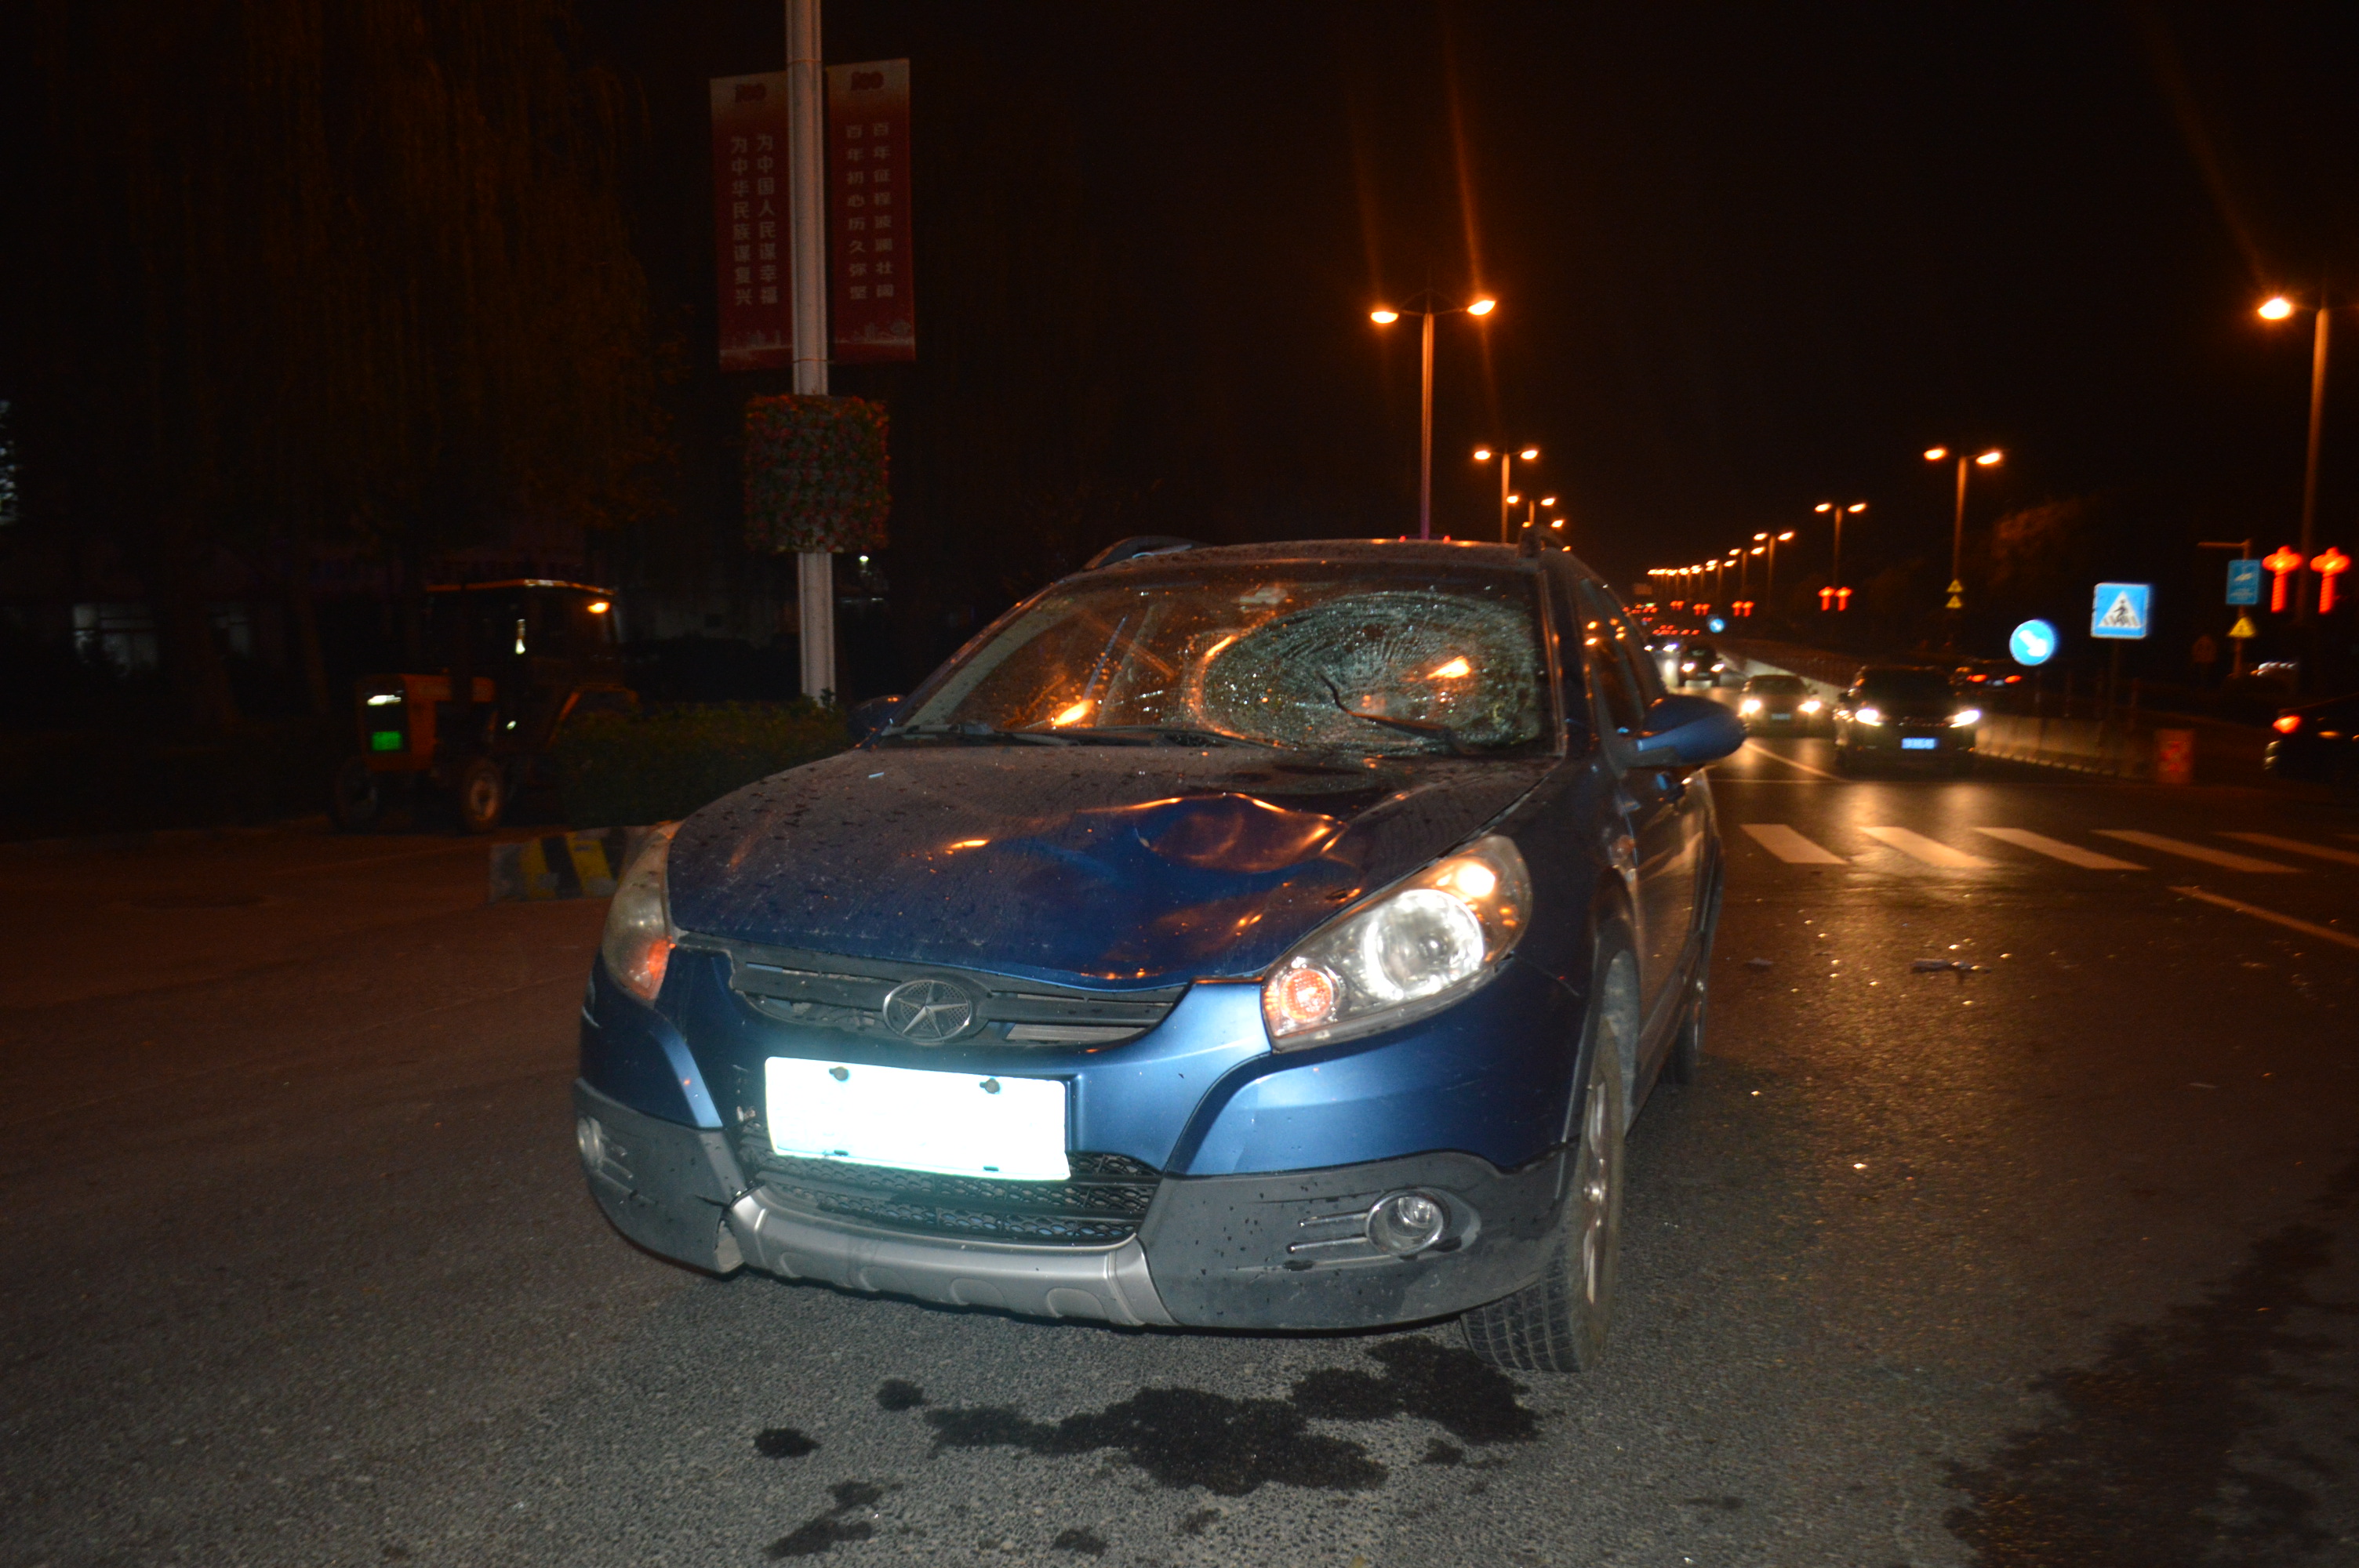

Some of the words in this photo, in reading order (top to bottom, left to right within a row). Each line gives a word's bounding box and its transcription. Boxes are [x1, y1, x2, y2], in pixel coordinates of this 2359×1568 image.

[730, 136, 753, 306] 为中华民族谋复兴
[756, 133, 778, 305] 为中国人民谋幸福
